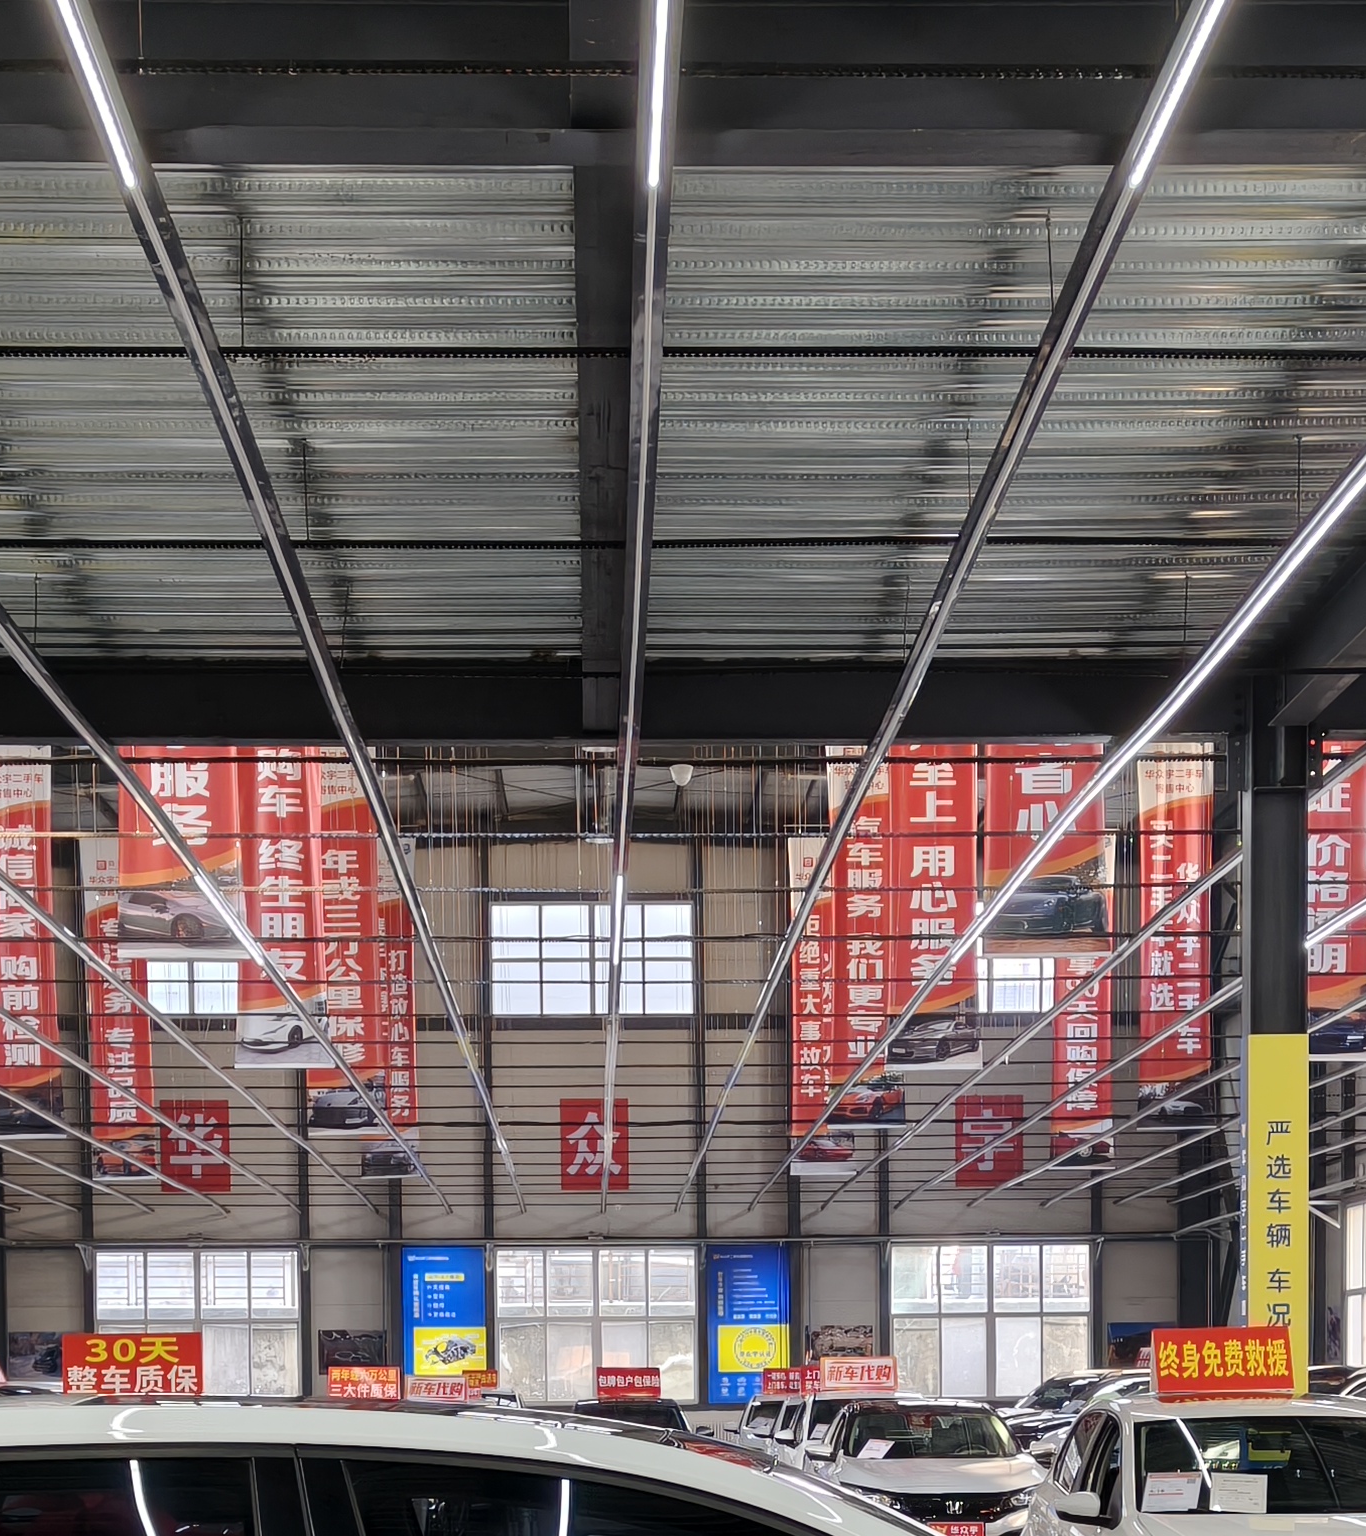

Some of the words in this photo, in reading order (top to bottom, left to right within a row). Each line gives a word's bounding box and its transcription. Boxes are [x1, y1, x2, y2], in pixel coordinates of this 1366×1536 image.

[256, 749, 304, 818] 购车
[846, 816, 884, 918] 汽车服务
[257, 838, 307, 981] 终生朋友
[909, 845, 957, 987] 用心服务
[0, 955, 42, 1066] 购前检测
[846, 932, 885, 1059] 我们更专业
[167, 1113, 223, 1179] 华
[565, 1111, 623, 1177] 众
[961, 1107, 1015, 1172] 宇
[1265, 1120, 1292, 1248] 严选车辆
[66, 1364, 199, 1394] 整车质保
[85, 1336, 180, 1364] 30天
[827, 1364, 892, 1382] 新车代购
[1158, 1338, 1289, 1379] 终身免费救援
[329, 1383, 398, 1398] 三大件质保
[409, 1382, 463, 1396] 新车代购
